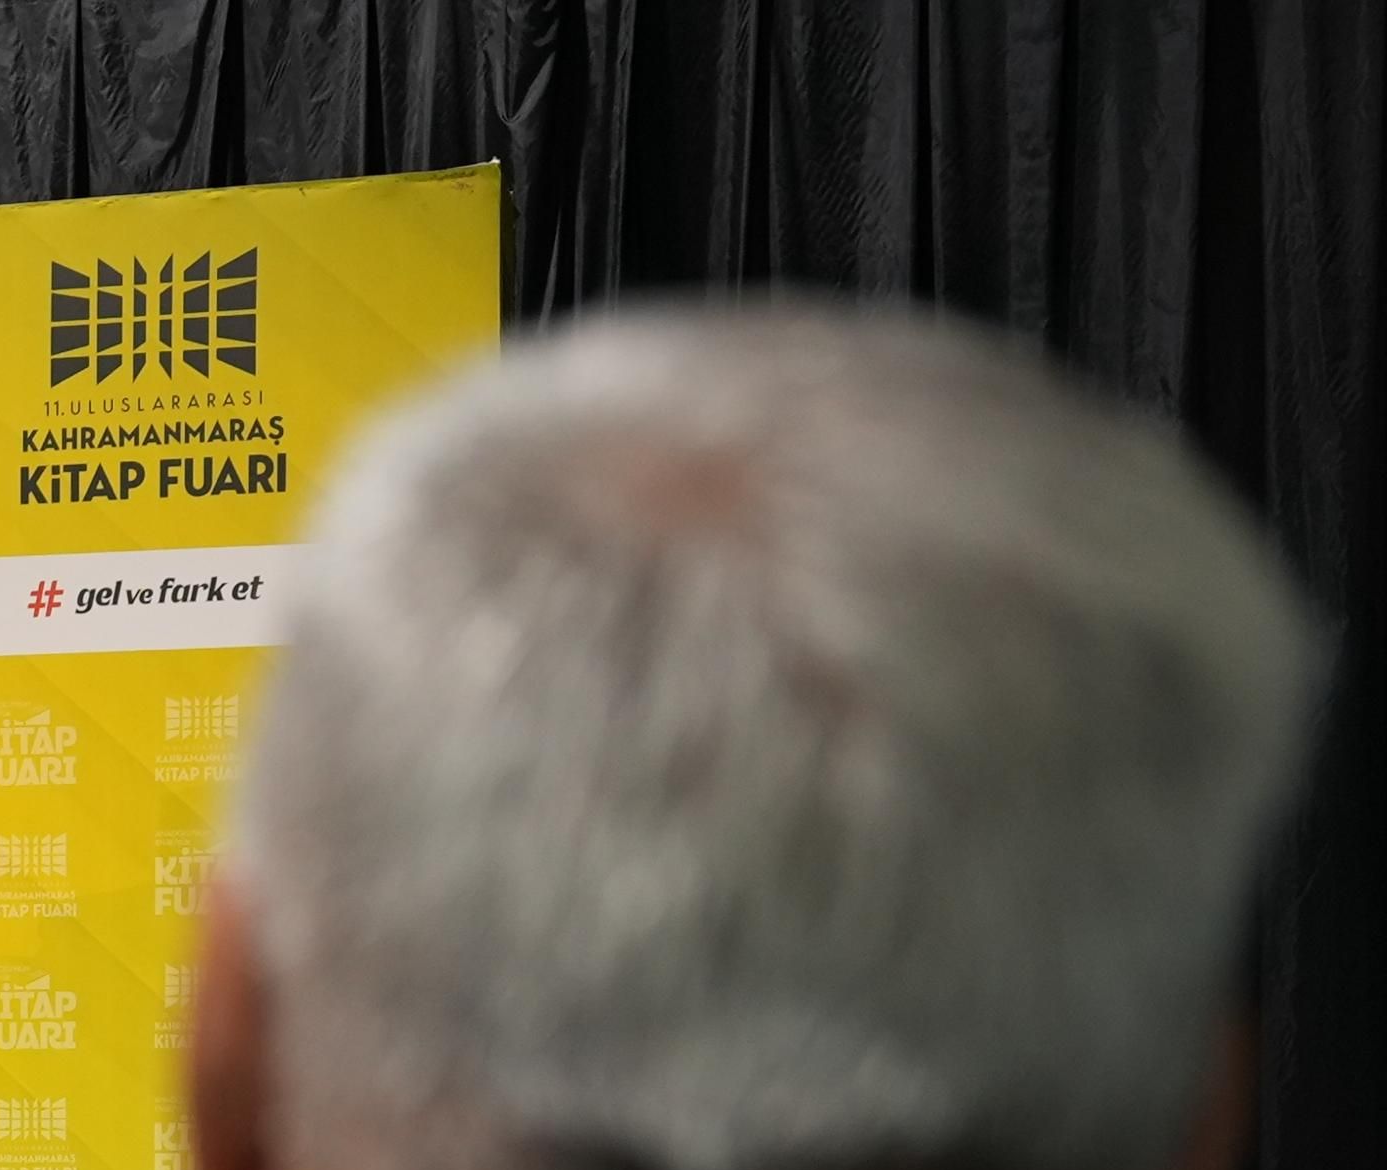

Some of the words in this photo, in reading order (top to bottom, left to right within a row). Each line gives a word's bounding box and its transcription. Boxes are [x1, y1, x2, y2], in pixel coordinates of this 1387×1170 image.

[22, 415, 285, 453] KAHRAMANMARAŞ
[159, 453, 287, 499] FUARI
[158, 578, 227, 604] fark
[231, 575, 264, 601] et
